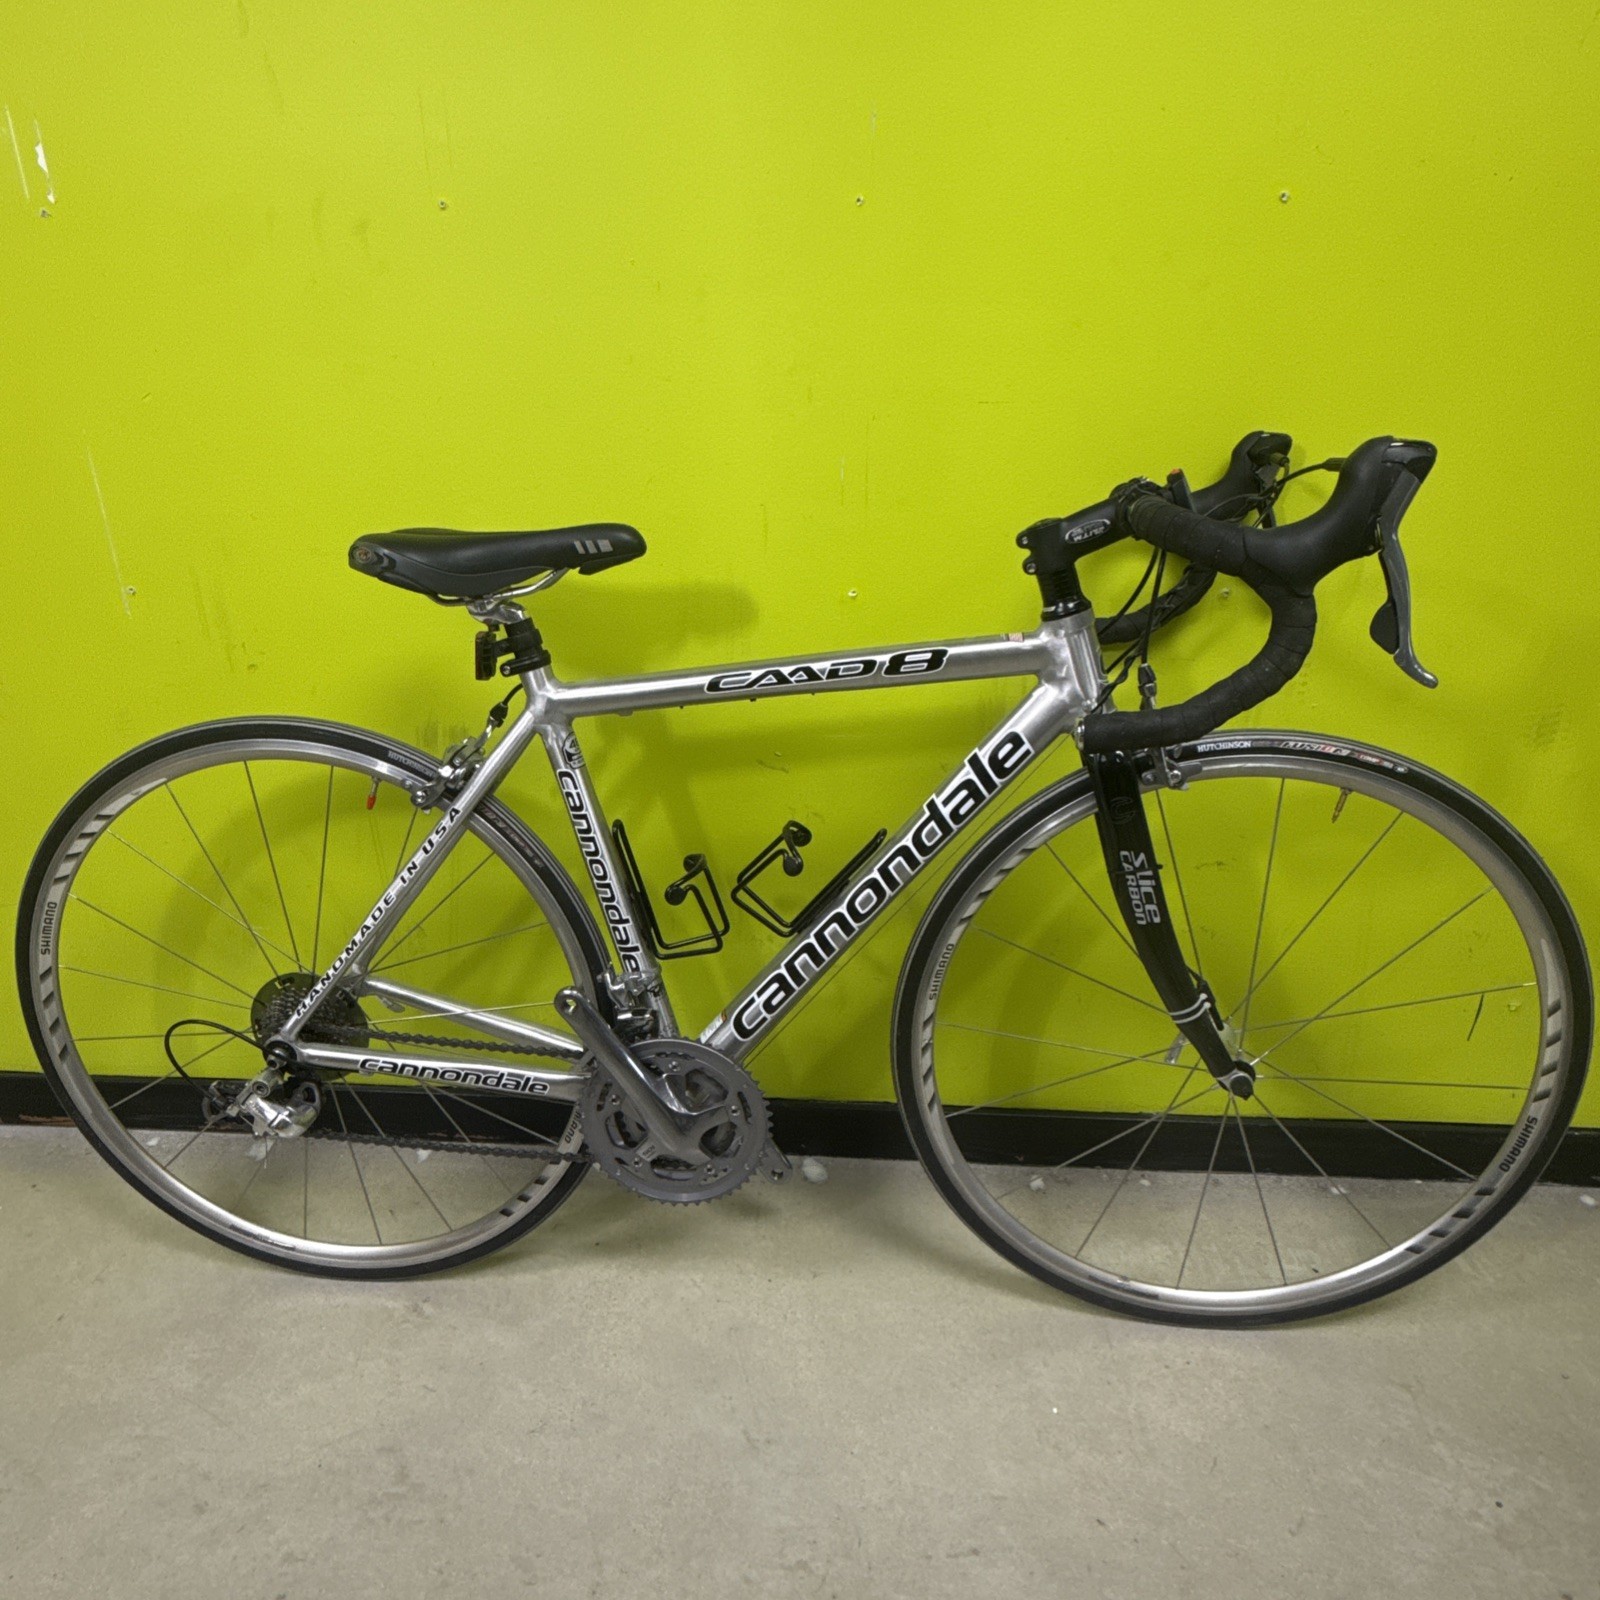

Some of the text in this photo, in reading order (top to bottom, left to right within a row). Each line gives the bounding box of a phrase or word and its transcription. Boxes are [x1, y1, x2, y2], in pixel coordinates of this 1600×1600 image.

[1197, 740, 1252, 753] HUTCHINSON
[557, 769, 641, 973] cannondale
[733, 730, 1034, 1040] cannondale
[41, 901, 57, 955] SHIMANO
[295, 807, 461, 1018] HANDMADE IN USA
[929, 943, 955, 1000] SHIMANO
[358, 1058, 550, 1095] cannondale
[1499, 1115, 1538, 1173] SHIMANO
